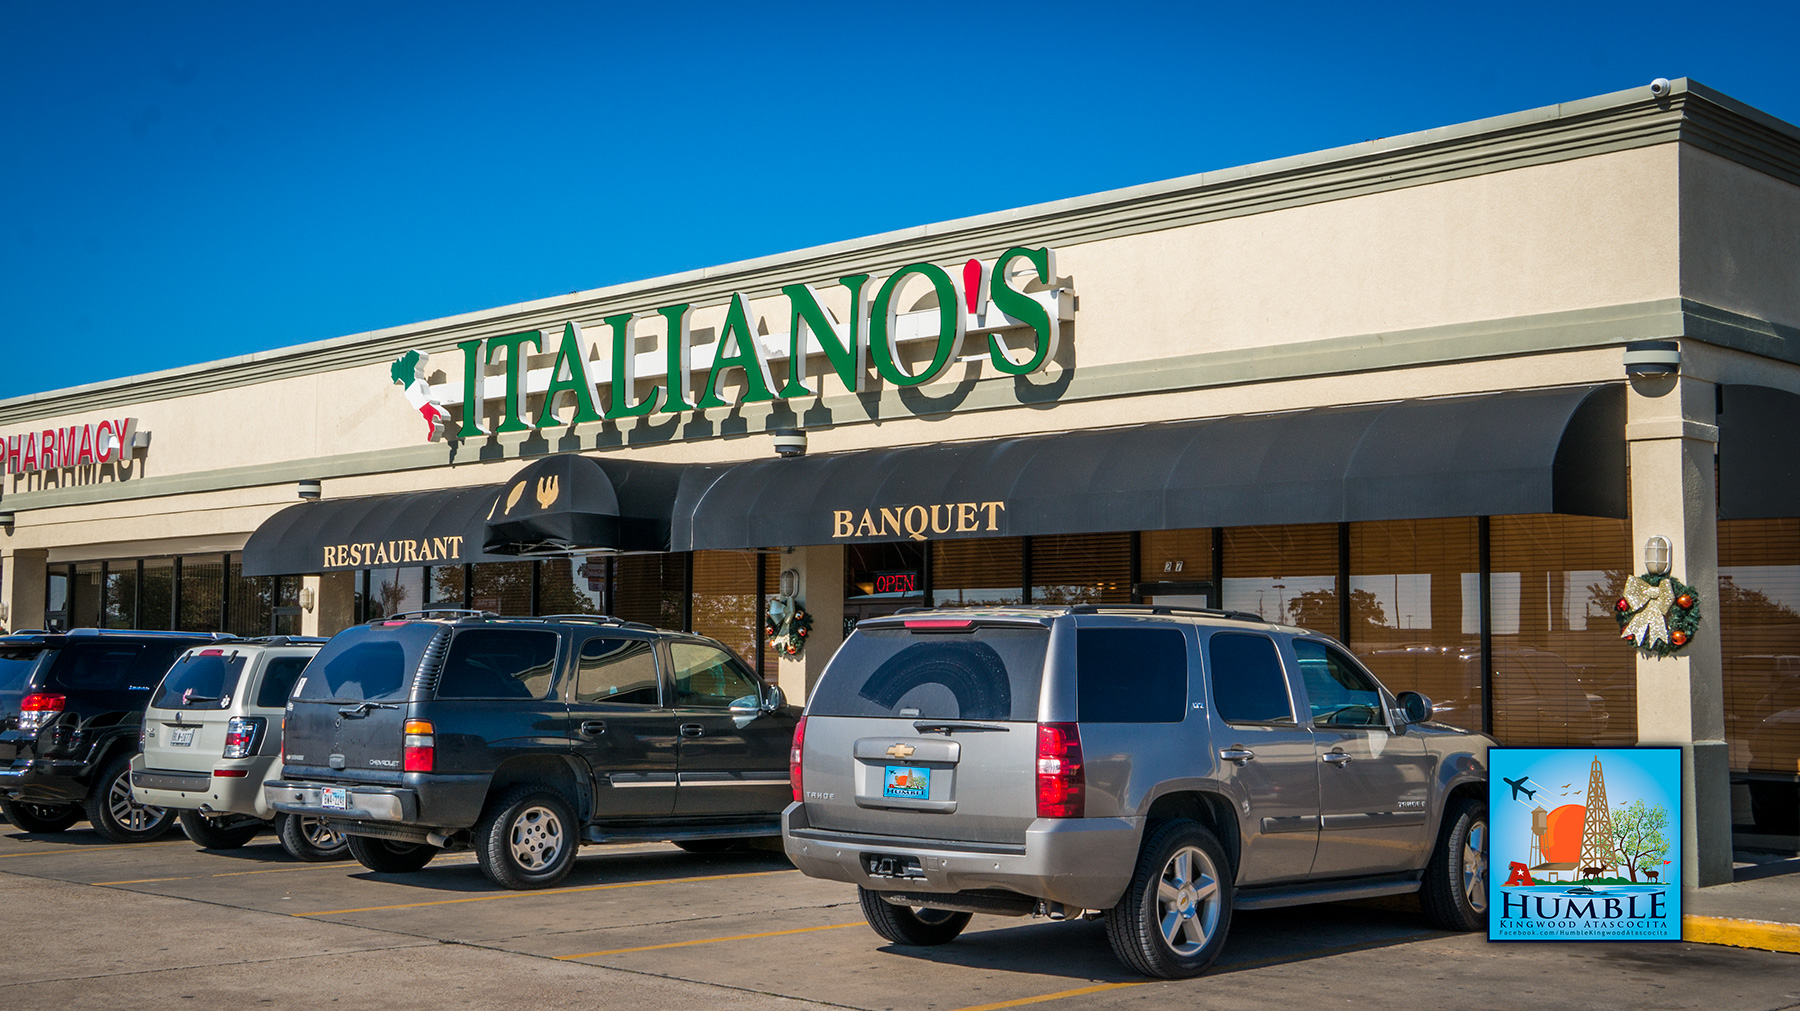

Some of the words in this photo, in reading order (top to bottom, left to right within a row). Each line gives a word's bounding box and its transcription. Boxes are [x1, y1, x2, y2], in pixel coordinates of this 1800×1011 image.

[457, 246, 1054, 438] ITALIANO'S
[832, 501, 1006, 541] BANQUET
[323, 536, 463, 567] RESTAURANT
[876, 574, 915, 592] OPEN
[806, 791, 836, 800] TAHOE
